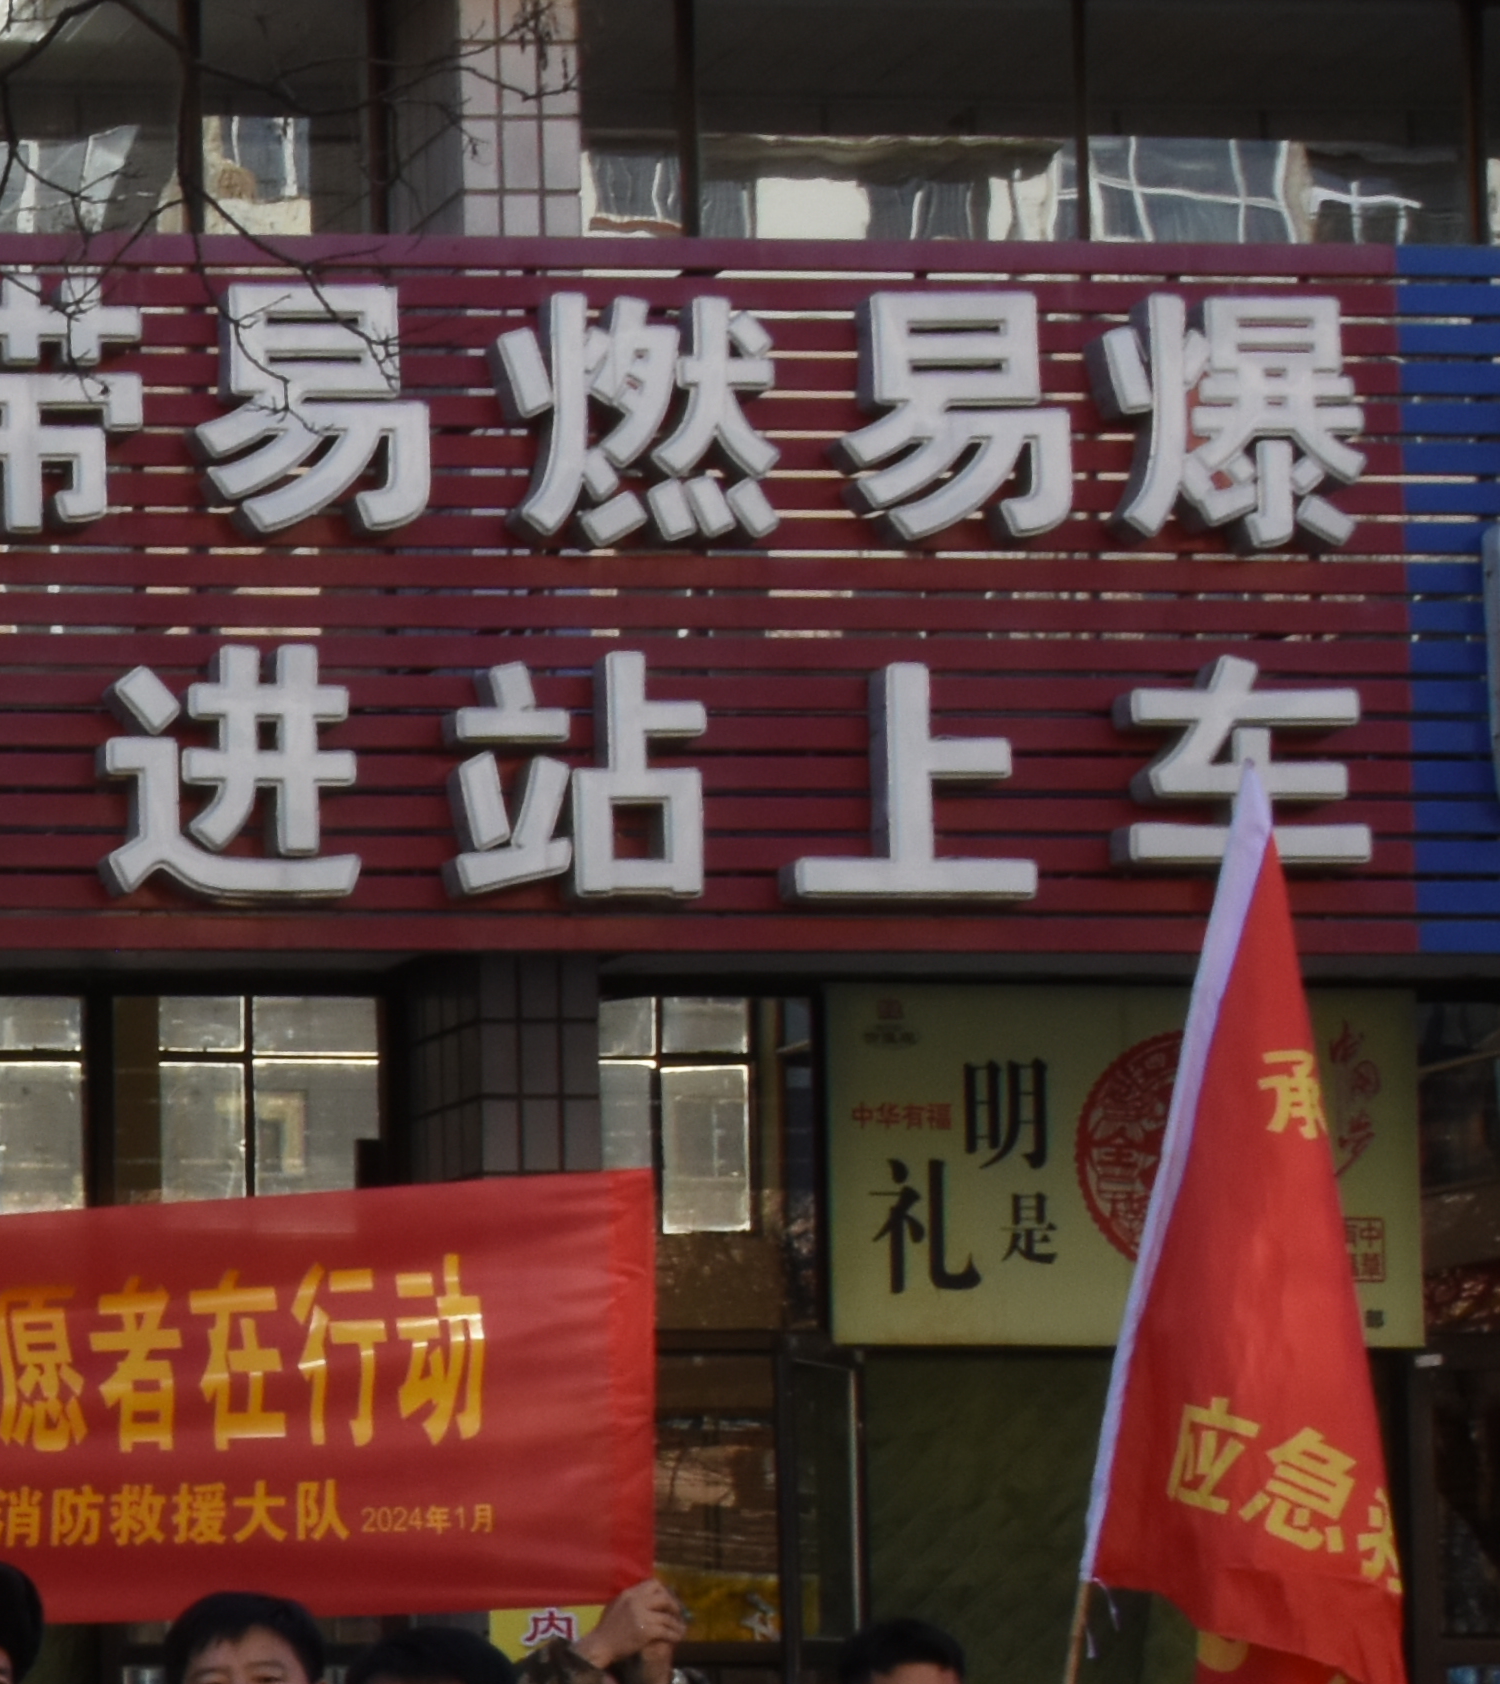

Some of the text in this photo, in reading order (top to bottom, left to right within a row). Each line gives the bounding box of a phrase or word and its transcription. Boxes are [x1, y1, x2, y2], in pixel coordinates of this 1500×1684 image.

[851, 1101, 953, 1132] 中华有福
[358, 1502, 497, 1537] 2024年1月
